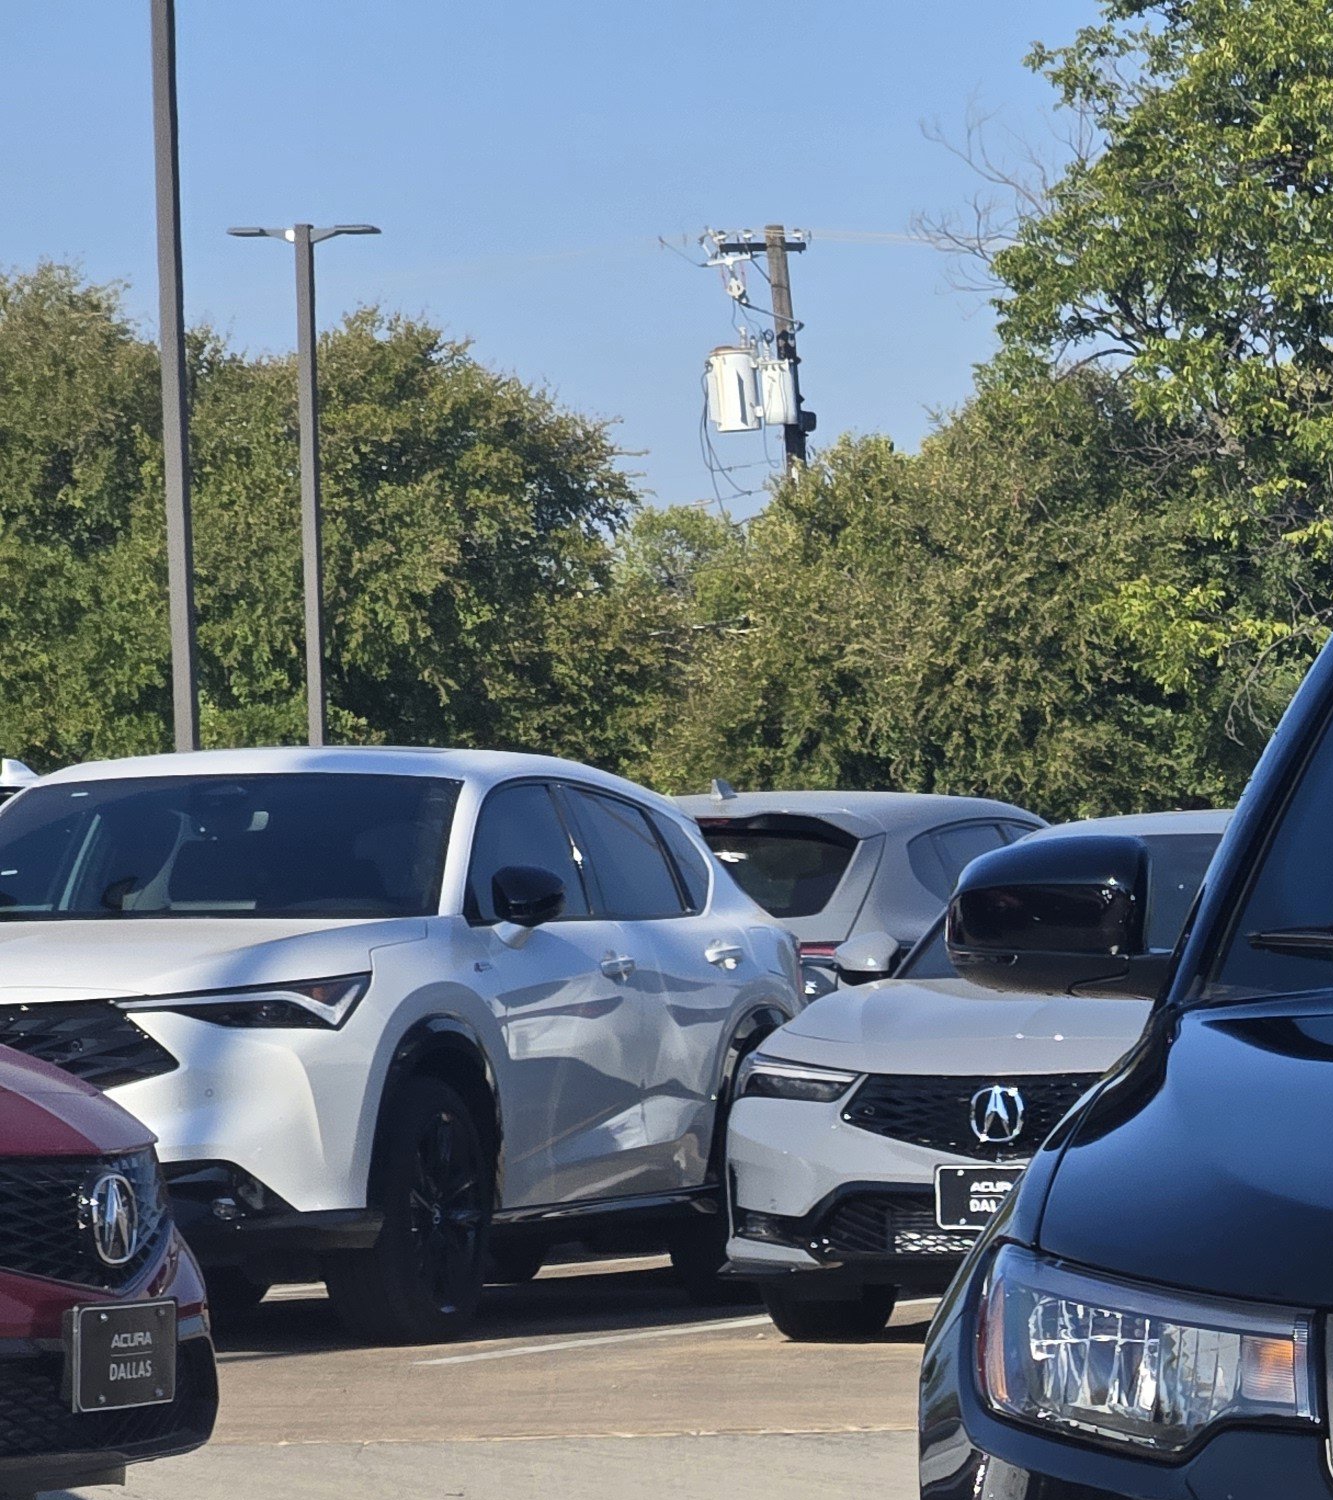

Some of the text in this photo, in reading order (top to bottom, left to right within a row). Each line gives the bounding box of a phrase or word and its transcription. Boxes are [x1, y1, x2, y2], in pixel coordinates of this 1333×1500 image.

[970, 1181, 1014, 1192] ACUR
[111, 1331, 152, 1348] ACURA
[109, 1360, 152, 1381] DALLAS
